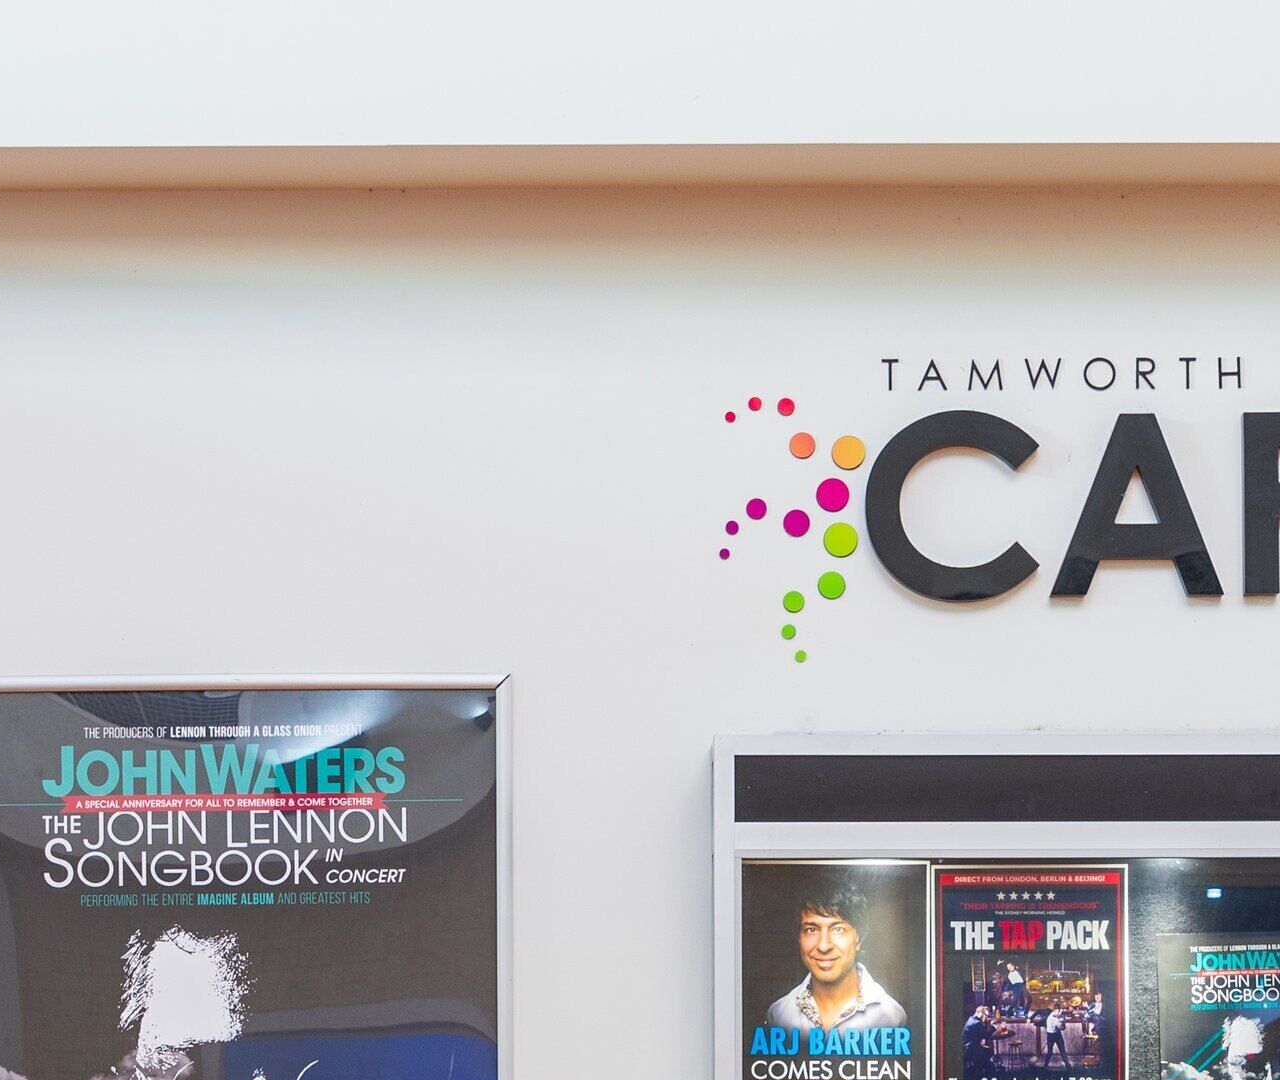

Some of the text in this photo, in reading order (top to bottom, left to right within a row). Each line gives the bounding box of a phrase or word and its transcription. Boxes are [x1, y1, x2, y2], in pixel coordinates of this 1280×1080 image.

[882, 355, 1246, 392] TAMWORTH
[83, 724, 363, 739] THE PRODUCERS OF LENNON THROUGH A GLASS ONION PRESENT
[42, 743, 406, 798] JOHN WATERS
[42, 807, 407, 850] THE JOHN LENNON
[43, 838, 319, 888] SONGBOOK
[325, 848, 343, 863] IN
[326, 868, 406, 884] CONCERT
[950, 920, 1110, 950] THE TAP PACK
[750, 1026, 911, 1055] ARJ BARKER
[751, 1060, 911, 1080] COMES CLEAN
